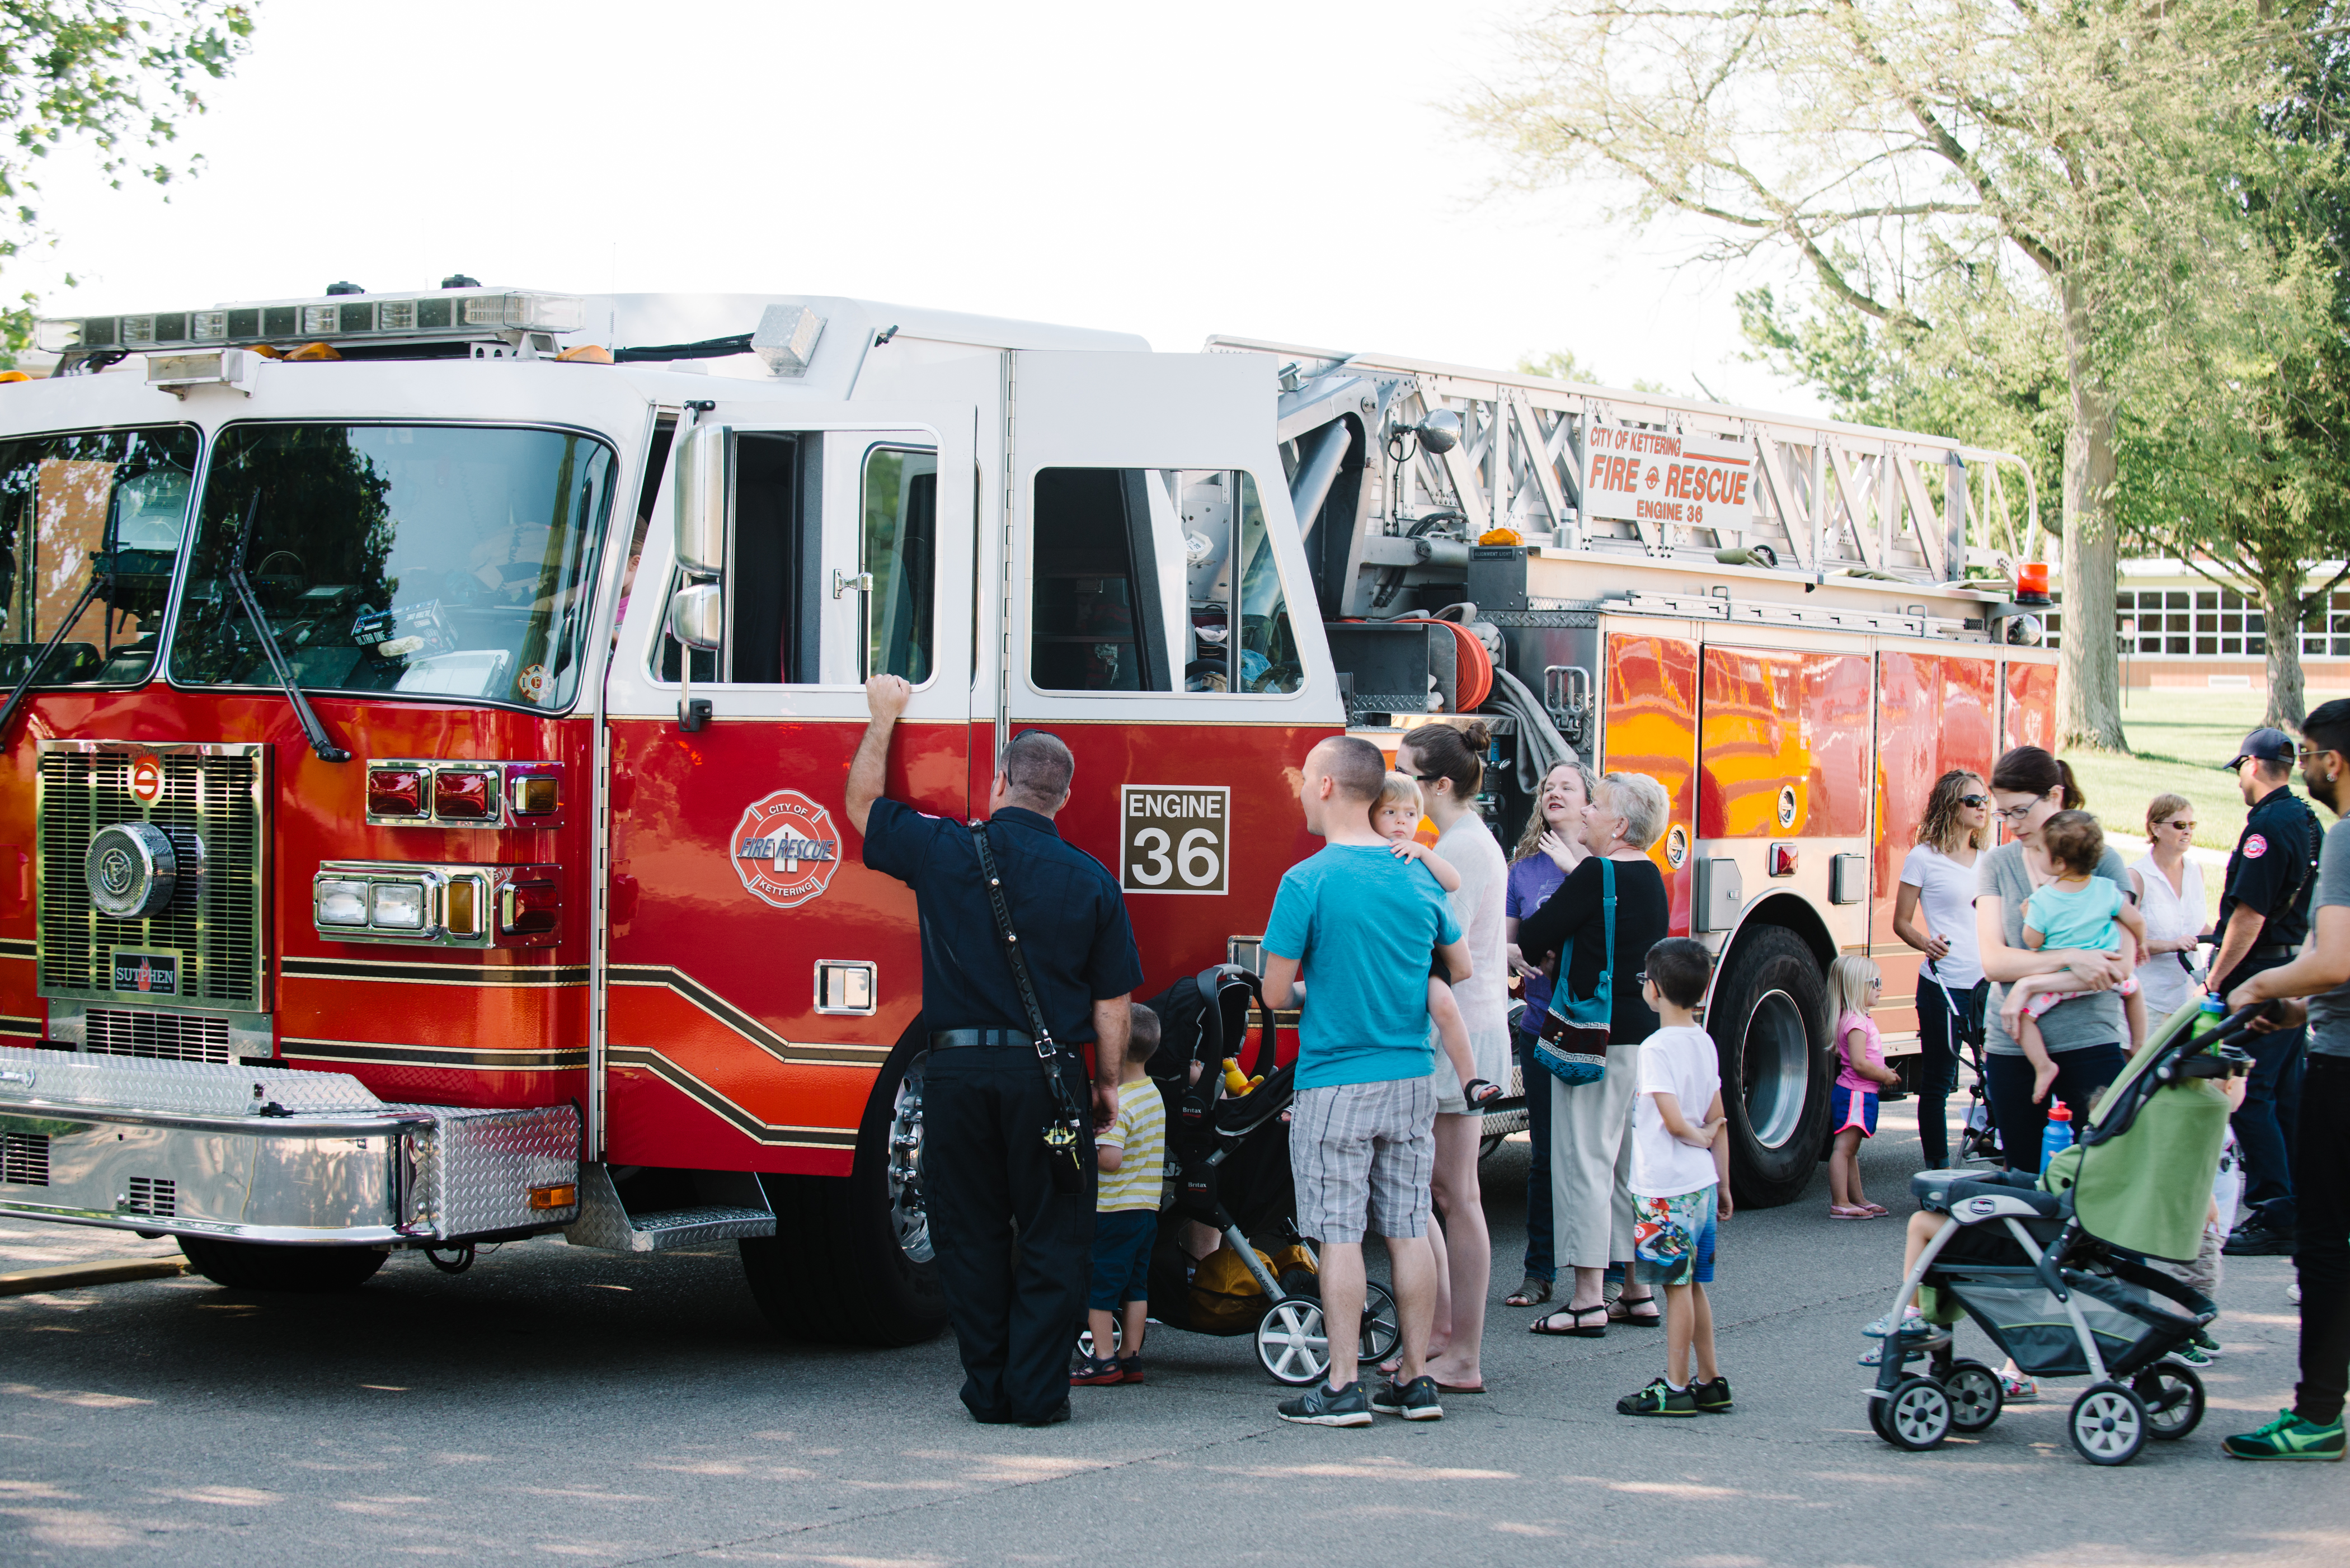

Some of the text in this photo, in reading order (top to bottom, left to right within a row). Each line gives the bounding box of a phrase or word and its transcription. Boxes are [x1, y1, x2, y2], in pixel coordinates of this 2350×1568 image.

[1590, 426, 1681, 457] CITY OF KETTERING
[1589, 454, 1749, 505] FIRE RESCUE
[1637, 499, 1703, 523] ENGINE 36
[355, 630, 387, 646] ULTRA ONE
[769, 803, 809, 815] CITY OF
[1129, 794, 1221, 818] ENGINE
[739, 837, 835, 860] FIRE RESCUE
[1131, 827, 1220, 887] 36
[759, 879, 813, 896] KETTERING
[116, 967, 174, 983] SUTPHEN
[1257, 1273, 1275, 1296] B-AGILE
